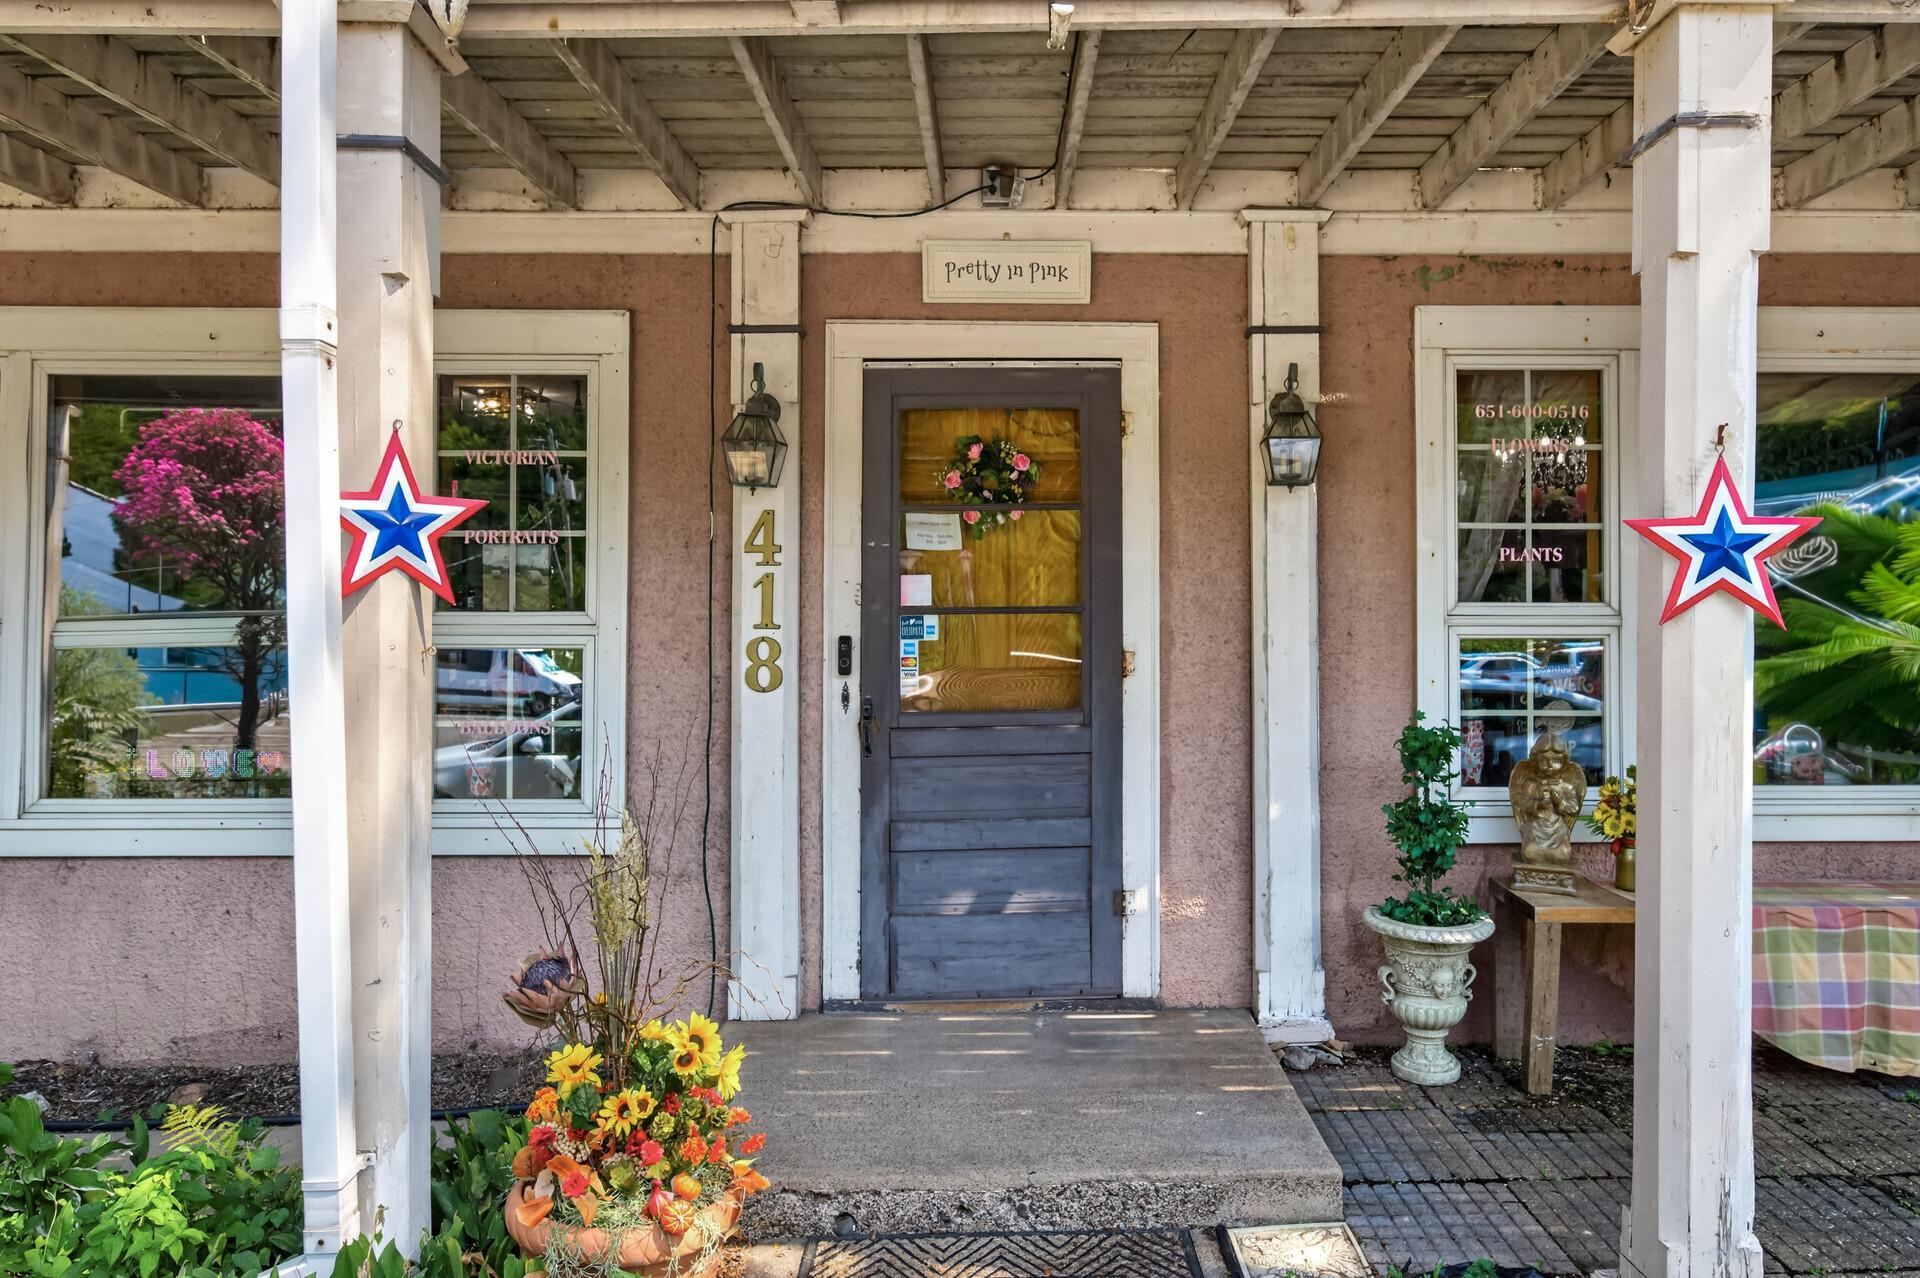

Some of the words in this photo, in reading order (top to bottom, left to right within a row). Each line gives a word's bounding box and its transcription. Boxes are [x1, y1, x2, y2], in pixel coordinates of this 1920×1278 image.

[945, 260, 1001, 283] Pretty
[1007, 265, 1023, 280] in
[1028, 262, 1069, 284] Pink
[1475, 404, 1590, 419] 651-600-0516
[1491, 438, 1569, 453] FLOWERS
[464, 450, 559, 465] VICTORIAN
[464, 529, 559, 545] PORTRAITS
[1499, 547, 1563, 562] PLANTS
[744, 509, 783, 693] 418
[460, 719, 552, 736] BALLOONS
[146, 749, 255, 778] LOVE
